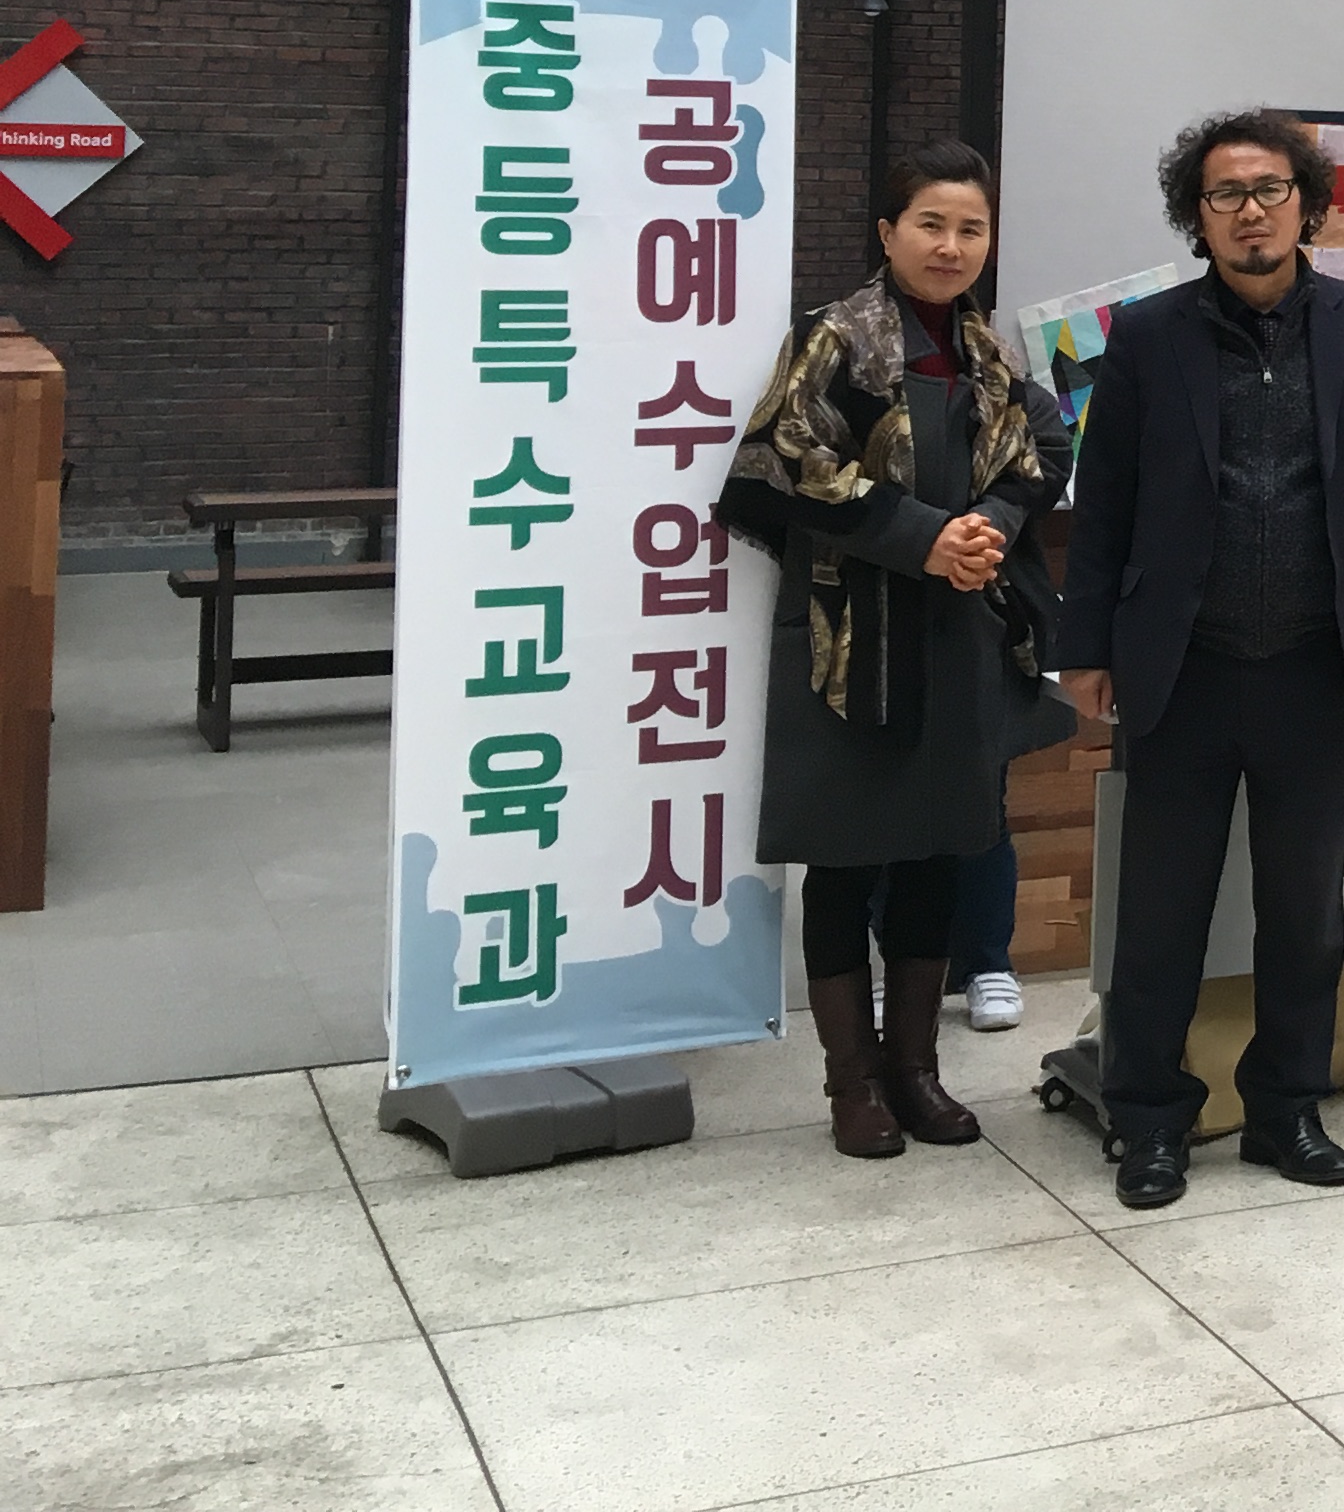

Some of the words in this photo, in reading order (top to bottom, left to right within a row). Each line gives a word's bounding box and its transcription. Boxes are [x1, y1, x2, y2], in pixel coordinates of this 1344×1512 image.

[0, 130, 65, 149] hinking
[70, 133, 112, 147] Road
[457, 0, 582, 1006] 중등특수교육과
